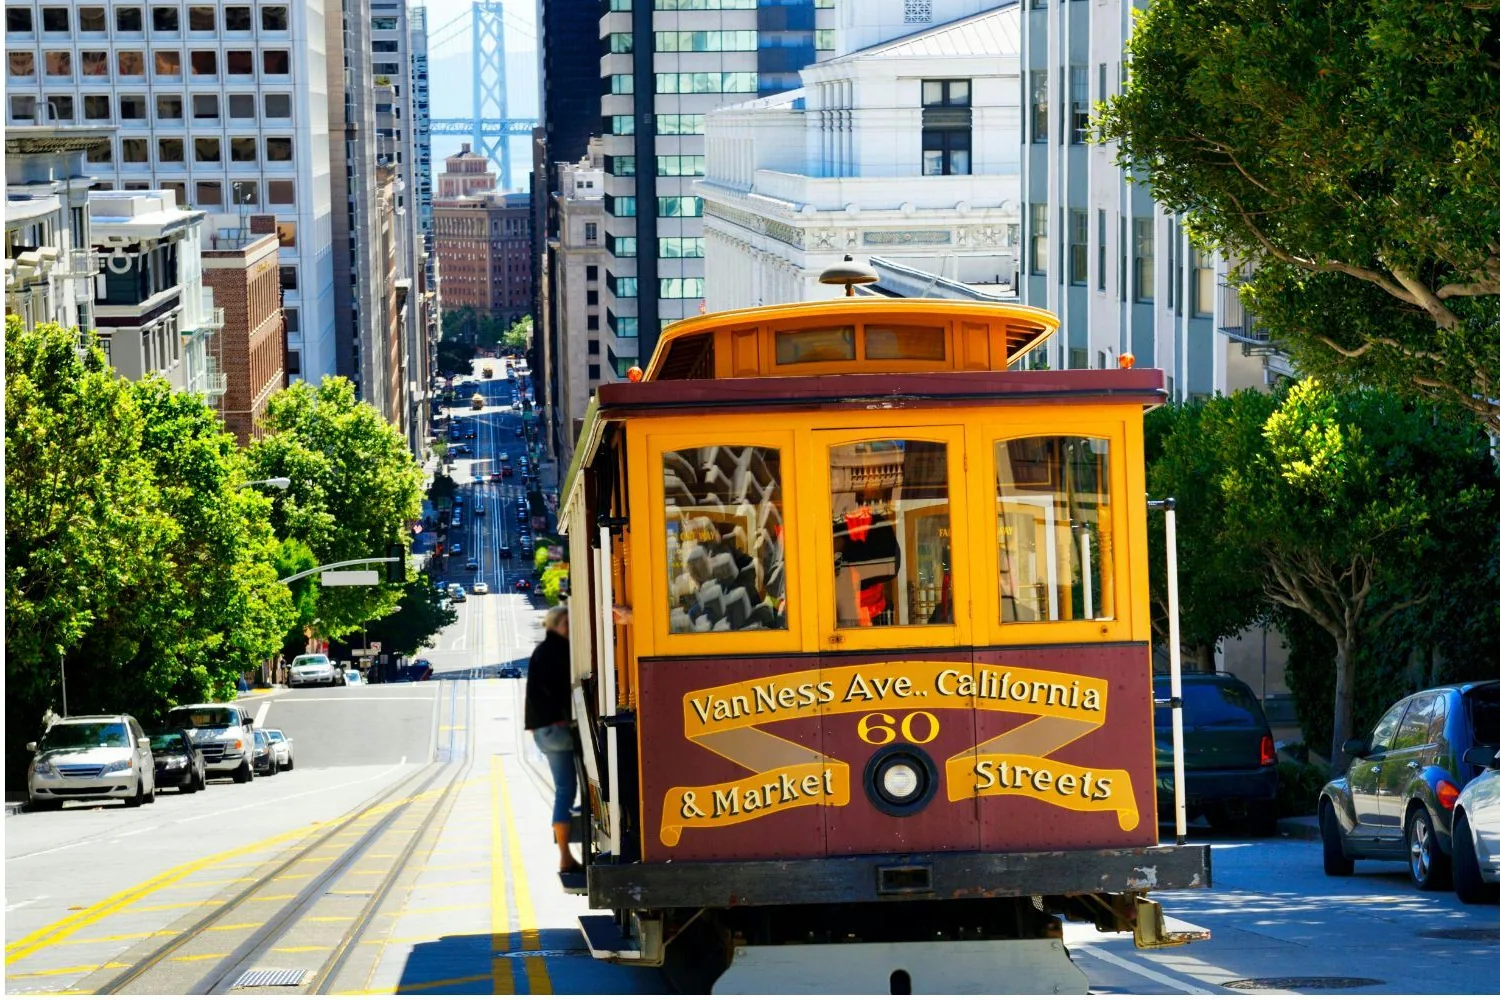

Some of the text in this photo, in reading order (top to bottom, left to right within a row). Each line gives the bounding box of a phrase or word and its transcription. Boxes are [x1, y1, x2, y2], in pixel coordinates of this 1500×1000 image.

[691, 694, 750, 726] Van
[752, 680, 835, 714] Ness
[935, 669, 1102, 712] California
[857, 711, 940, 745] 60
[681, 768, 835, 820] & Market
[974, 760, 1114, 802] Streets
